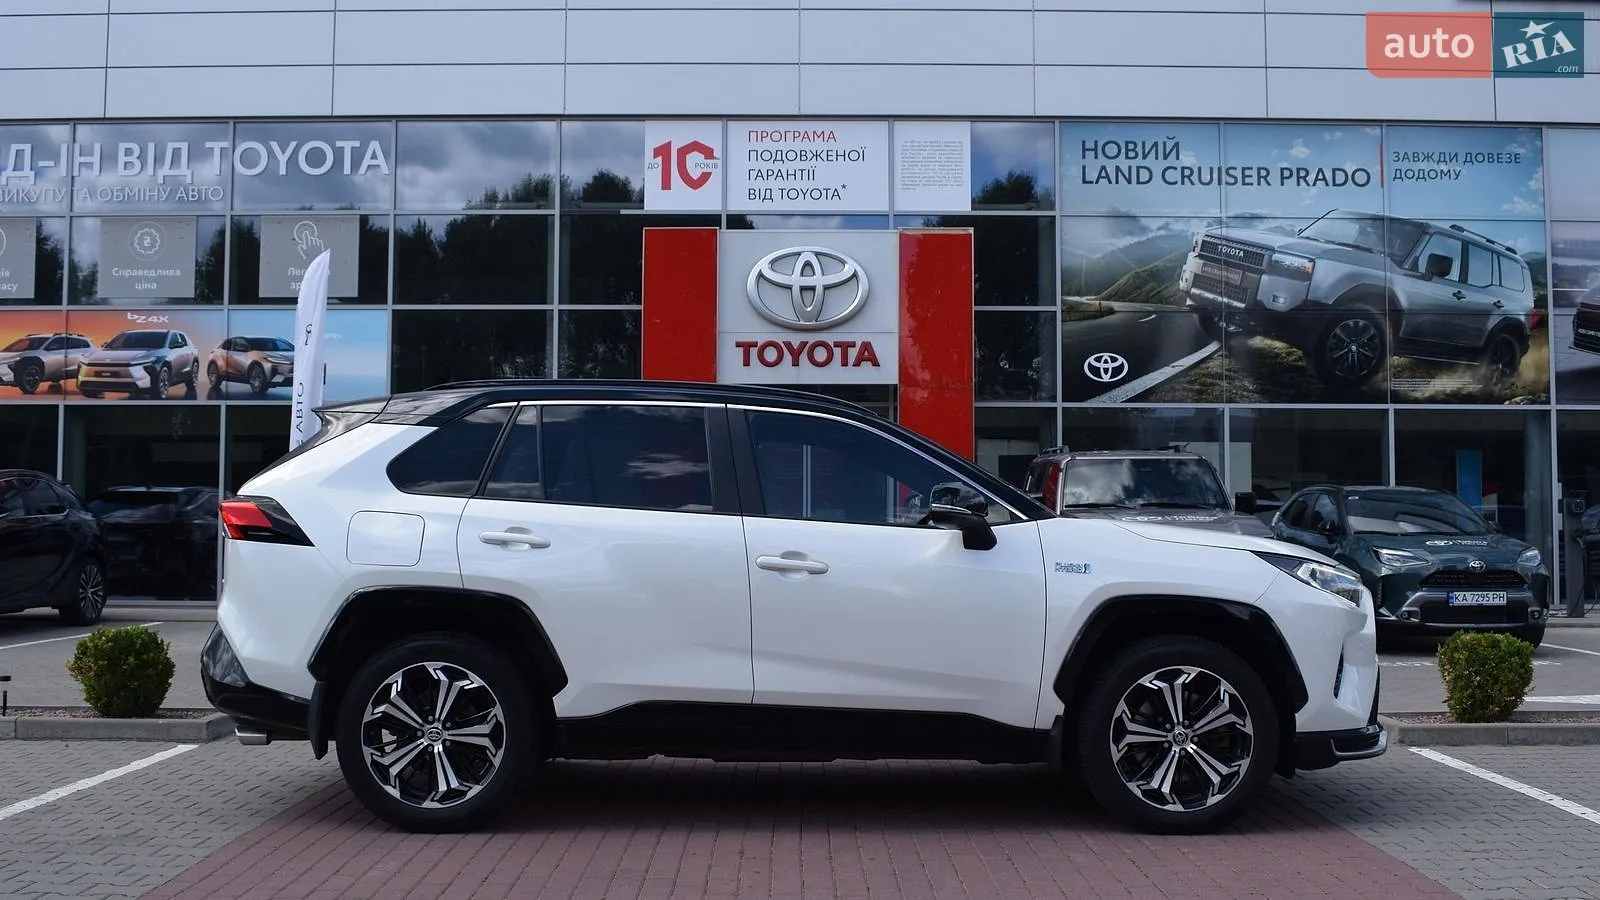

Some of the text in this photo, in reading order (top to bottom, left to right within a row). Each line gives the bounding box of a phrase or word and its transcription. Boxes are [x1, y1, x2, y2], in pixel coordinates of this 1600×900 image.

[748, 130, 837, 142] ПРОГРАМА
[1081, 135, 1180, 160] НОВИЙ
[118, 142, 193, 184] ВІД
[205, 140, 390, 176] TOYOTA
[748, 146, 866, 164] ПОДОВЖЕНОЇ
[1392, 151, 1522, 165] ЗАВЖДИ ДОВЕЗЕ
[647, 162, 660, 170] ДО
[748, 165, 817, 181] ГАРАНТІЇ
[1081, 165, 1371, 187] LAND CRUISER PRADO
[1392, 168, 1462, 182] ДОДОМУ
[72, 187, 91, 202] ТА
[97, 187, 171, 202] ОБМІНУ
[175, 186, 224, 201] АВТО
[748, 188, 774, 203] ВІД
[1218, 246, 1244, 257] TOYOTA
[112, 267, 181, 278] Справедлива
[135, 282, 157, 291] ціна
[735, 340, 881, 368] TOYOTA
[1470, 593, 1490, 603] 7295
